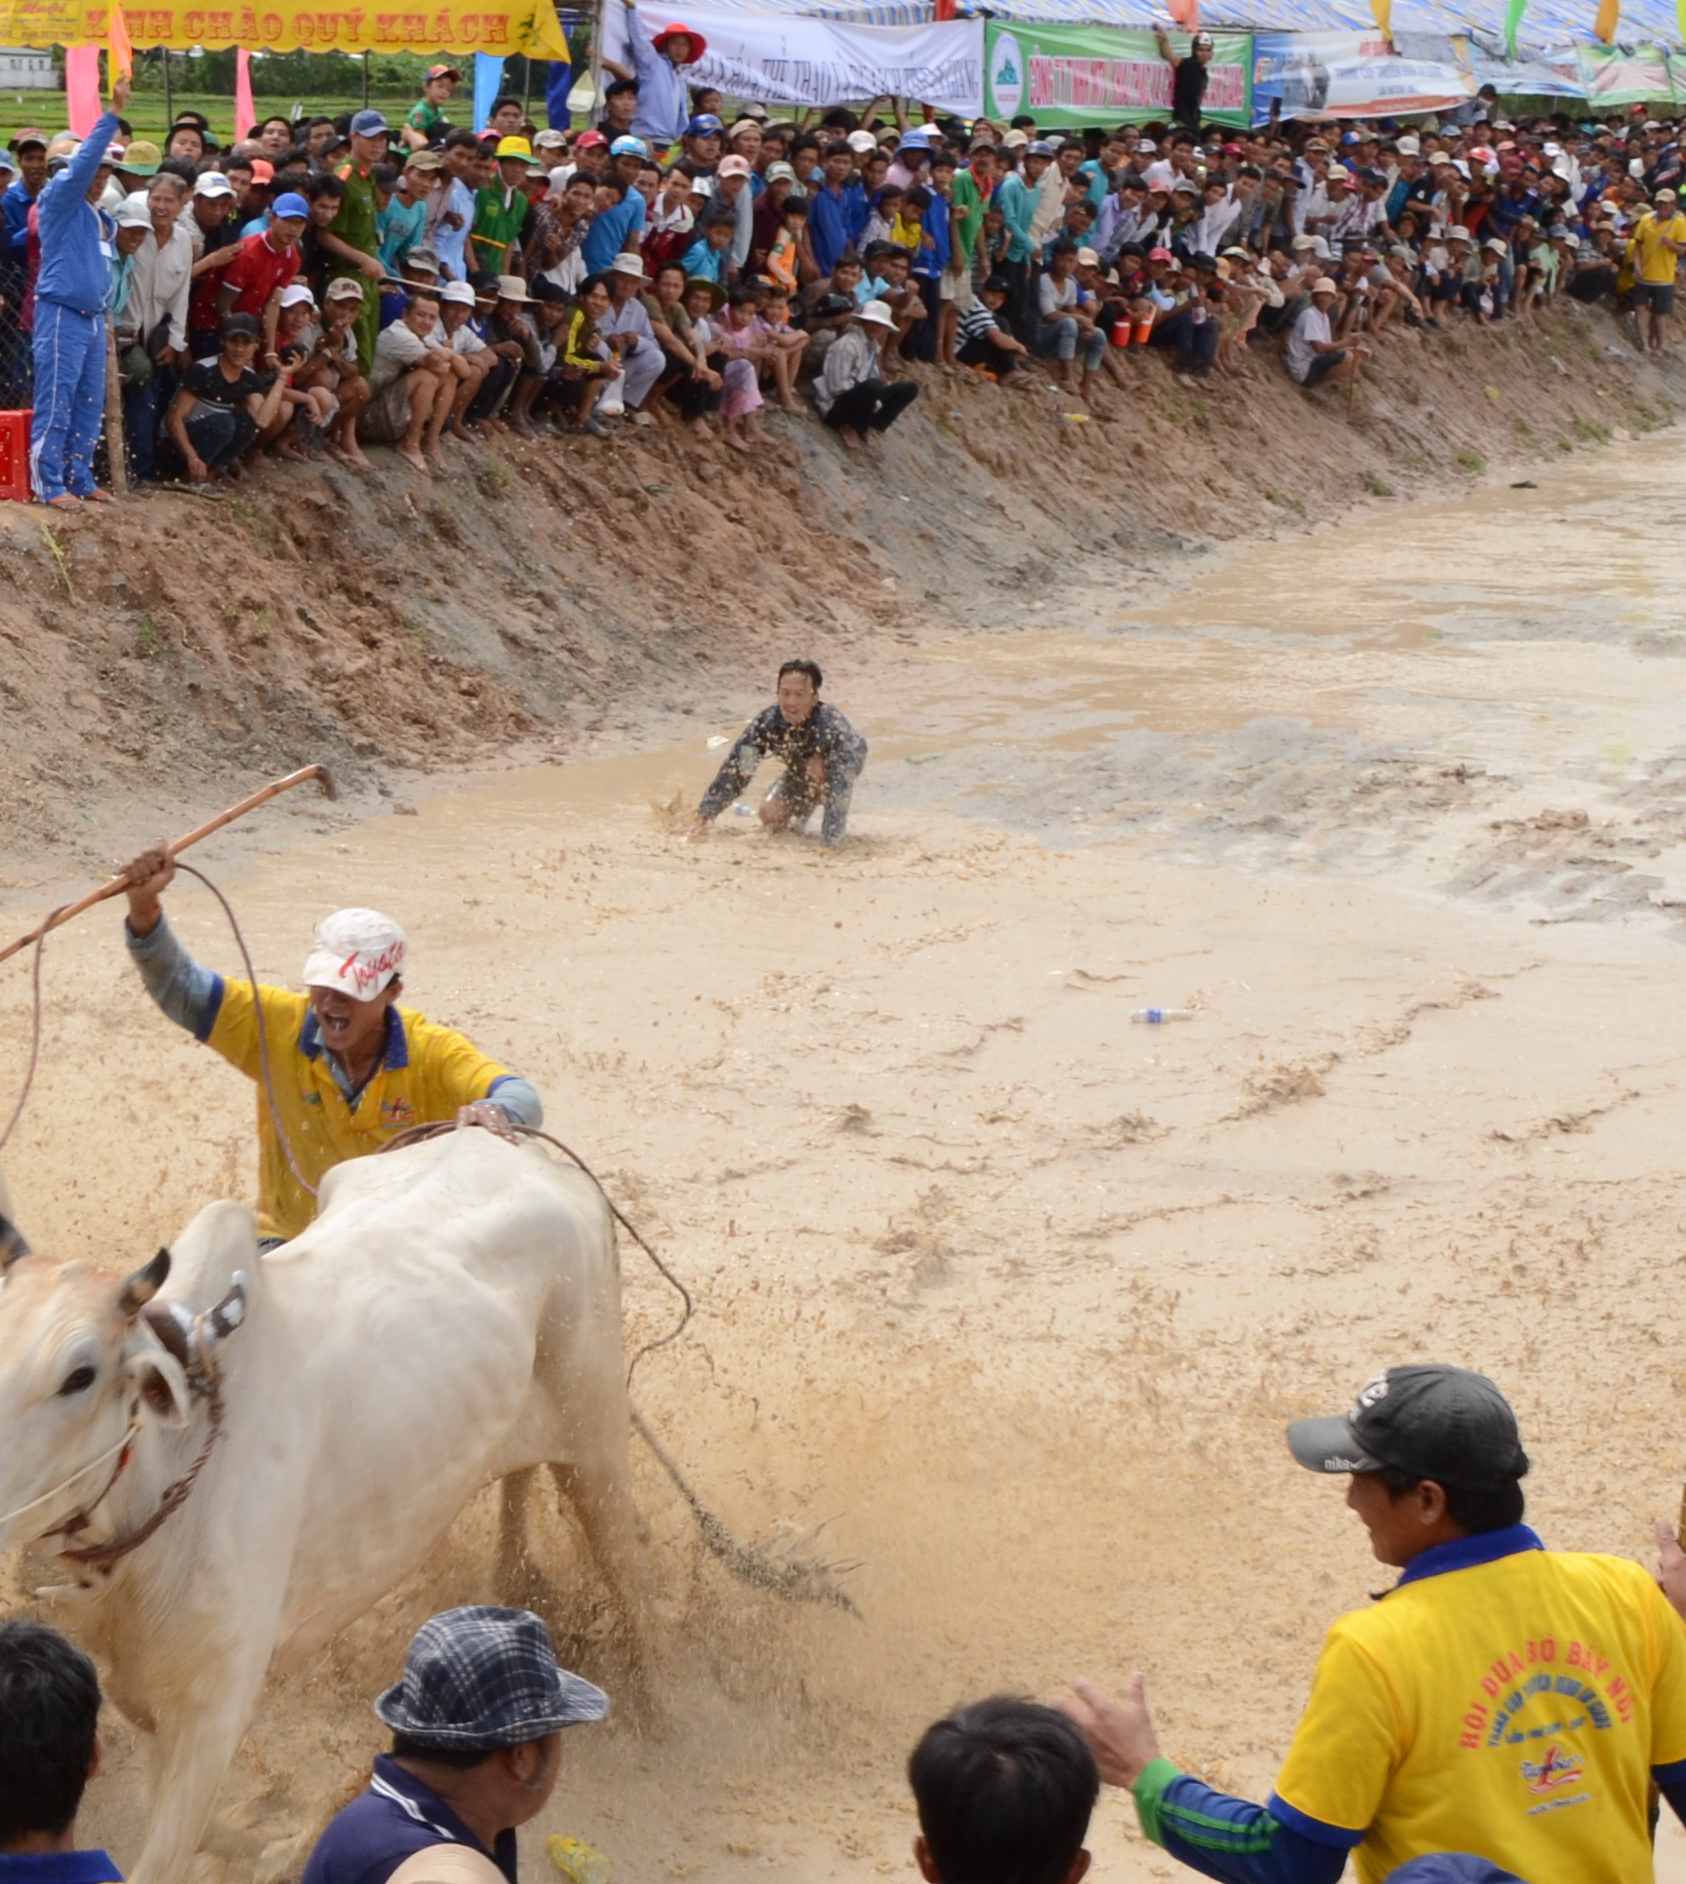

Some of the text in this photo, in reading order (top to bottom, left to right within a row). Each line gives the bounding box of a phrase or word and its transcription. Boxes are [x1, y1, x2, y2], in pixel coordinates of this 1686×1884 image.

[84, 5, 509, 46] KNH CHÀO QUÝ KHÁCH
